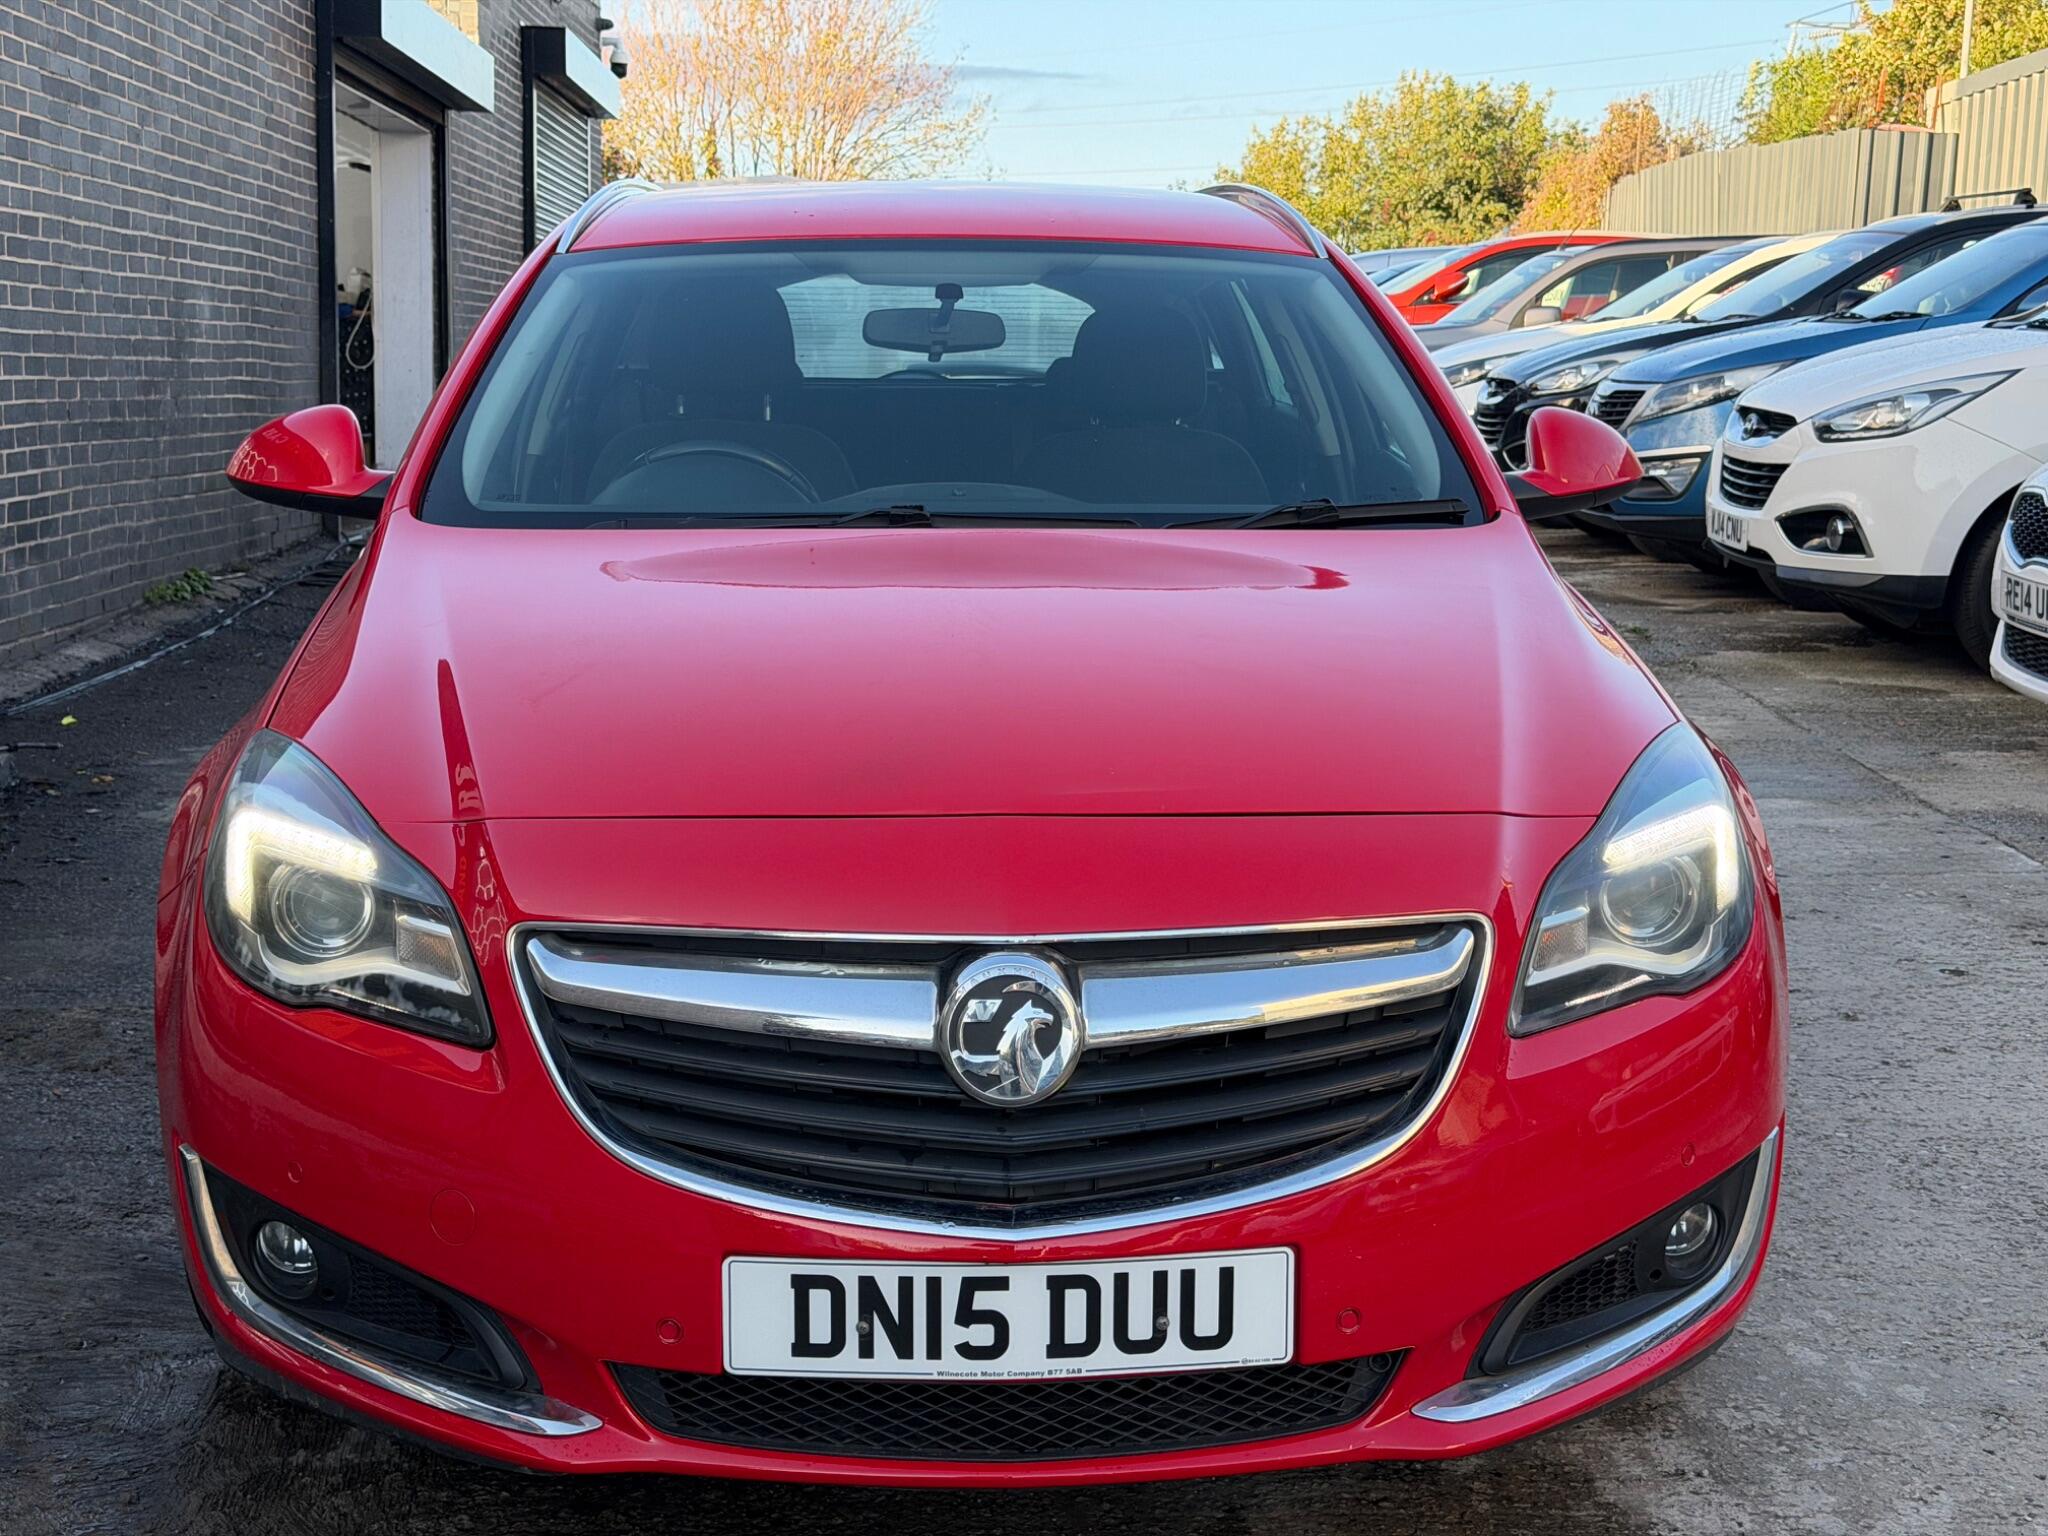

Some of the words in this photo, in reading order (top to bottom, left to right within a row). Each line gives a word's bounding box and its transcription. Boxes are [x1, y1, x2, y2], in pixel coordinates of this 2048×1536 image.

[1726, 515, 1743, 543] CNU
[2006, 577, 2032, 616] RE14
[2036, 585, 2048, 621] U
[790, 1273, 1010, 1361] DN15
[1046, 1266, 1235, 1359] DUU
[1007, 1369, 1045, 1378] Company
